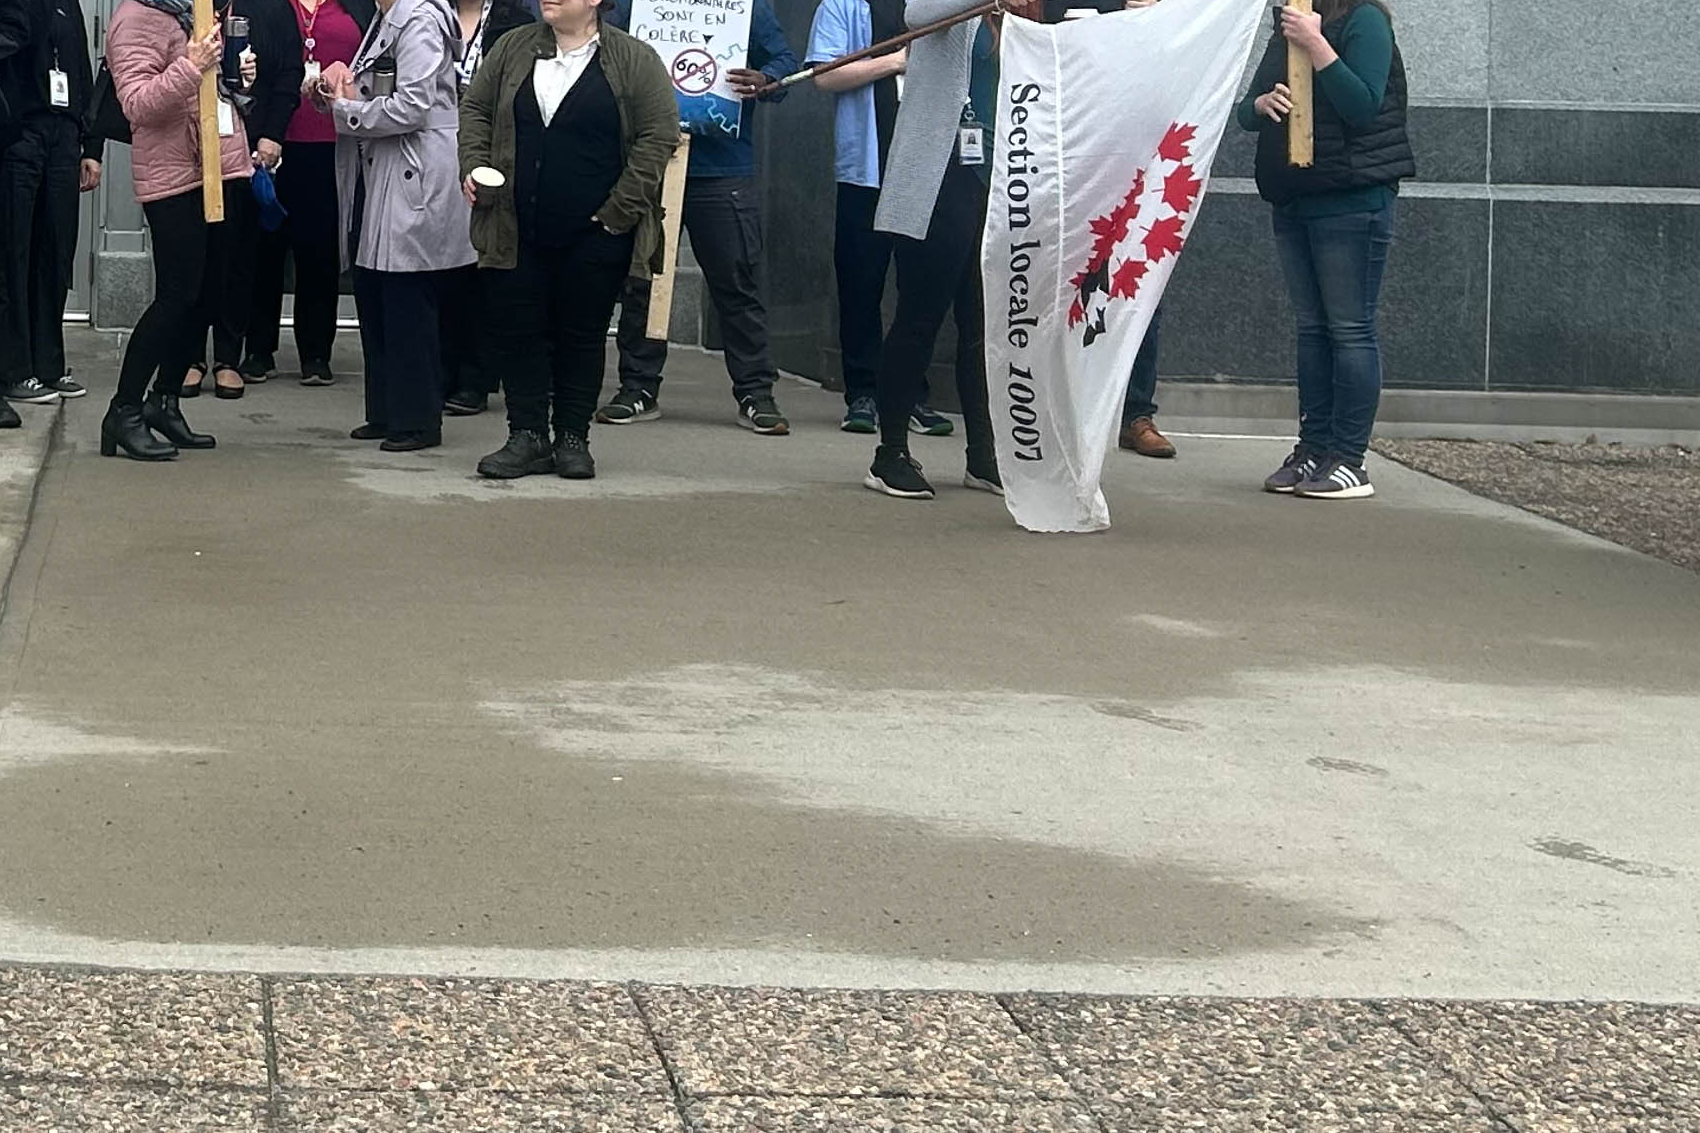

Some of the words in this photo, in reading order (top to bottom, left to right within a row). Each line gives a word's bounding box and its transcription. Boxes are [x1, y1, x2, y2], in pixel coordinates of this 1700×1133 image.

[653, 6, 694, 22] SONT
[705, 13, 726, 26] EN
[1007, 82, 1042, 231] Section
[1007, 240, 1041, 349] locale
[1008, 361, 1043, 462] 10007
